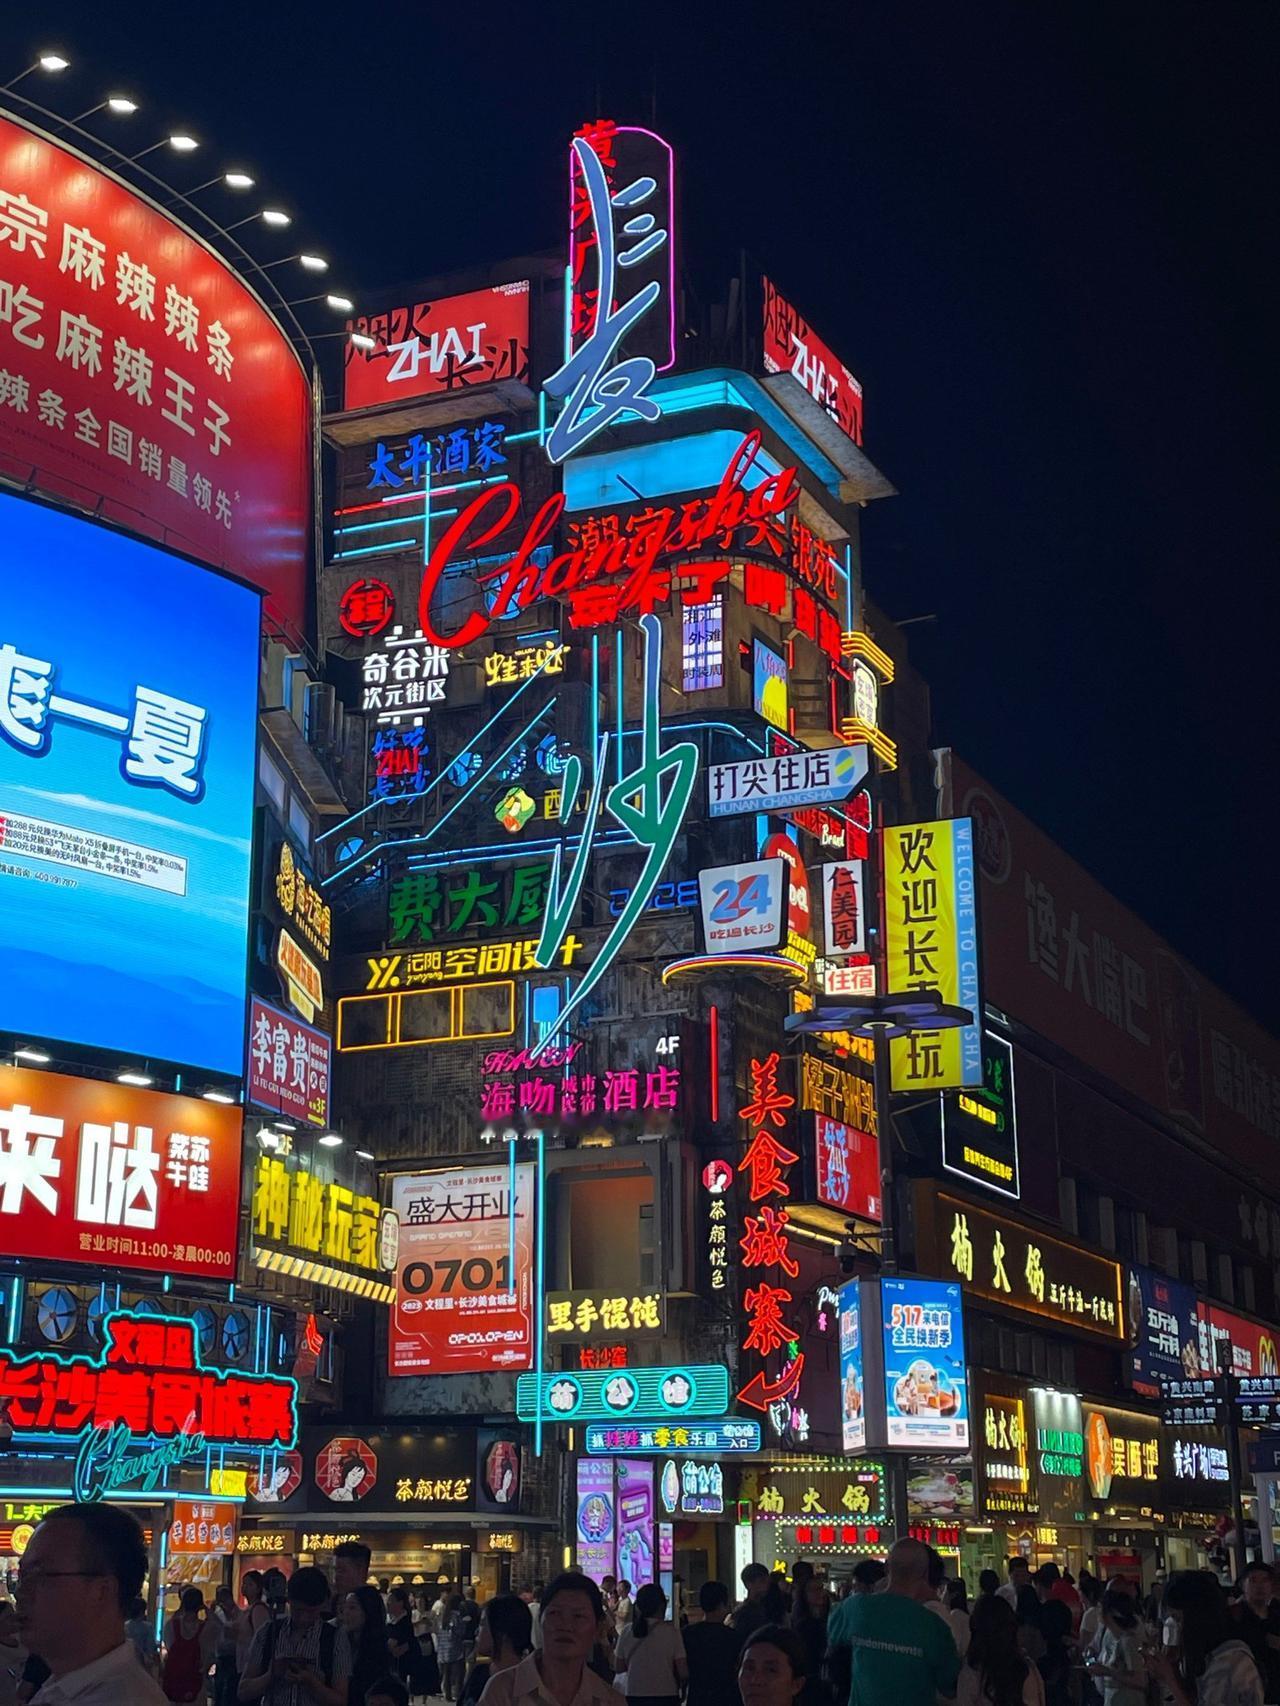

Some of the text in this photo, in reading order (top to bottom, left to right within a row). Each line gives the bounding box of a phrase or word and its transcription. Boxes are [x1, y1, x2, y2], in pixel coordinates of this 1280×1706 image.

[386, 322, 487, 384] ZHAI
[366, 421, 508, 489] 太平酒家
[417, 429, 800, 648] Changsha
[362, 645, 450, 683] 奇谷米
[362, 679, 448, 710] 次元街区
[713, 752, 831, 802] 打尖住店
[713, 789, 833, 813] HUNAN CHANGSHA
[957, 827, 974, 918] WELCOME
[709, 874, 773, 922] 24
[827, 866, 859, 948] 仁美园
[898, 828, 945, 1080] 欢迎长玩
[959, 927, 974, 951] TO
[827, 967, 875, 992] 住宿
[252, 1012, 310, 1094] 李富贵
[654, 1036, 681, 1055] 4F
[602, 1064, 681, 1113] 酒店
[168, 1131, 210, 1162] 紫苏
[164, 1159, 210, 1192] 牛蛙
[253, 1155, 382, 1270] 神秘玩家
[406, 1190, 525, 1226] 盛大开业
[738, 1052, 800, 1357] 美食城寨
[708, 1201, 729, 1290] 茶颜悦色
[402, 1254, 518, 1296] 0701
[547, 1295, 661, 1333] 里手馄饨
[74, 1410, 206, 1503] Changsha
[729, 1438, 748, 1449] 入口
[396, 1477, 470, 1502] 茶颜悦色
[237, 1534, 284, 1552] 茶颜悦色
